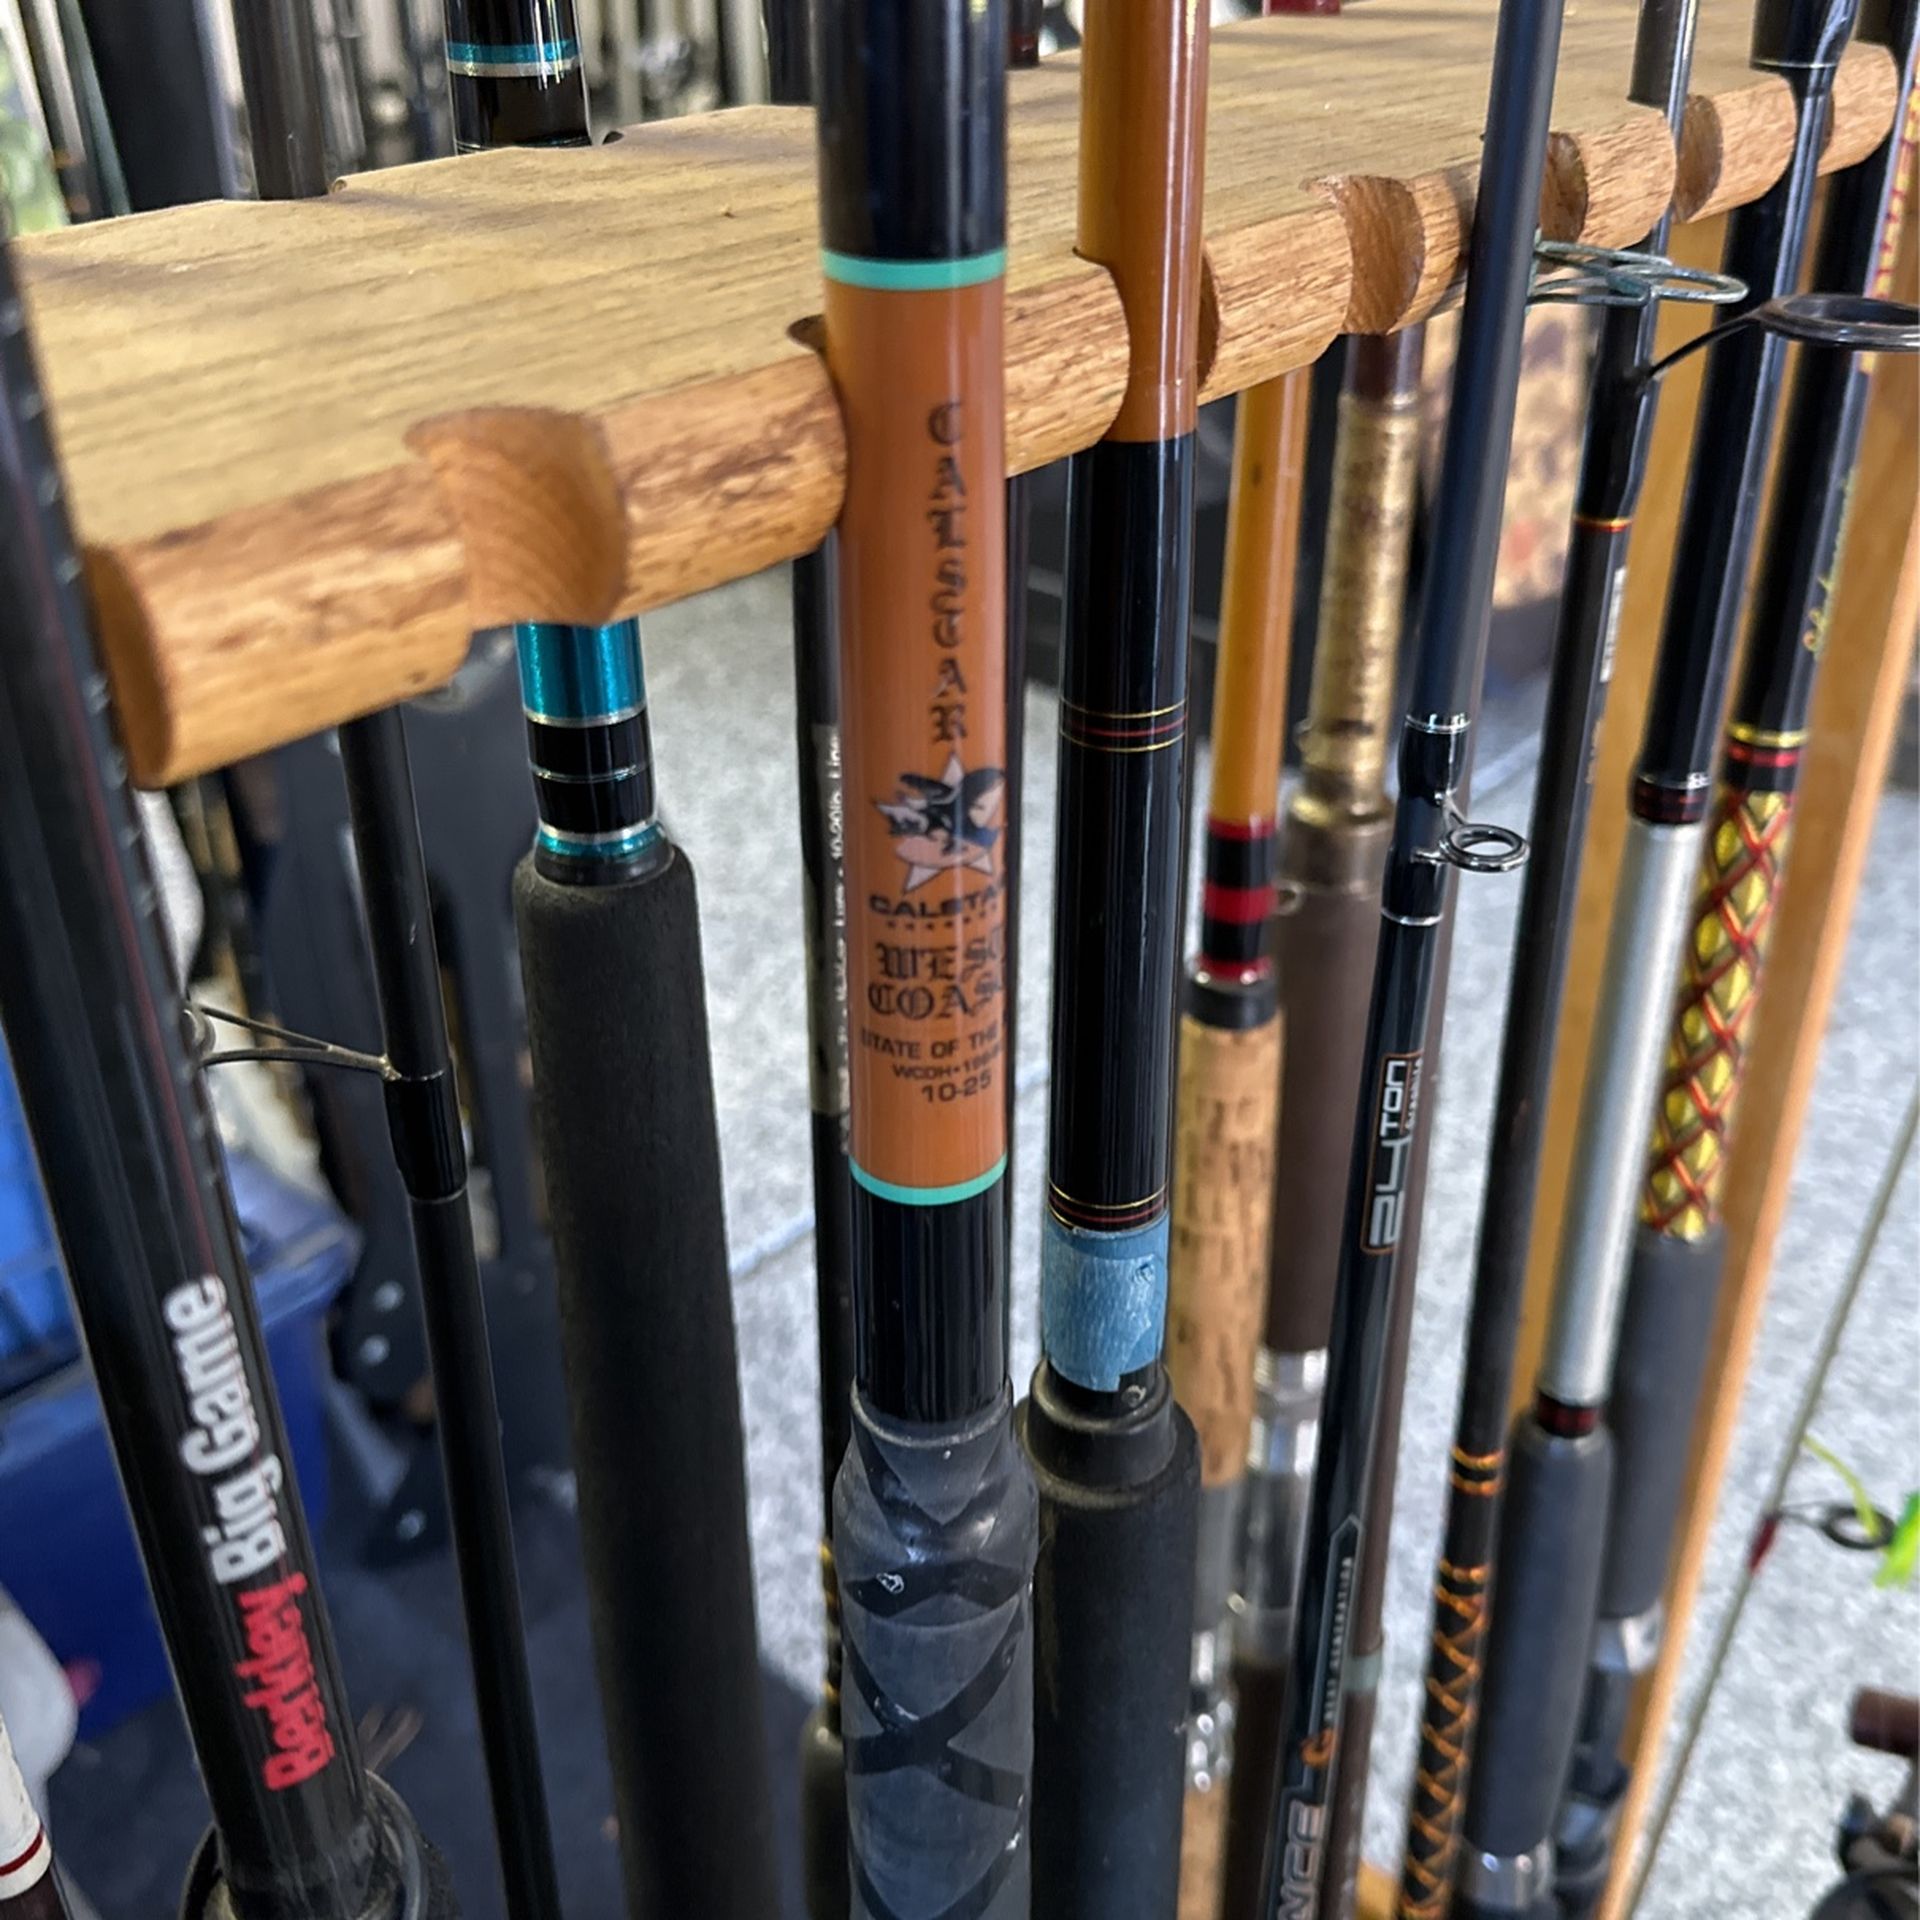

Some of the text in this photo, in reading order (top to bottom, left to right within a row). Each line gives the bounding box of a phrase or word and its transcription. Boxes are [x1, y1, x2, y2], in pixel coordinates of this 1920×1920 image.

[868, 875, 1004, 918] CALSTA
[861, 1027, 921, 1060] STATE
[931, 1039, 959, 1059] OF
[921, 1069, 992, 1104] 10-25
[1380, 1059, 1408, 1138] TON
[163, 1273, 336, 1792] Berkley Big Game
